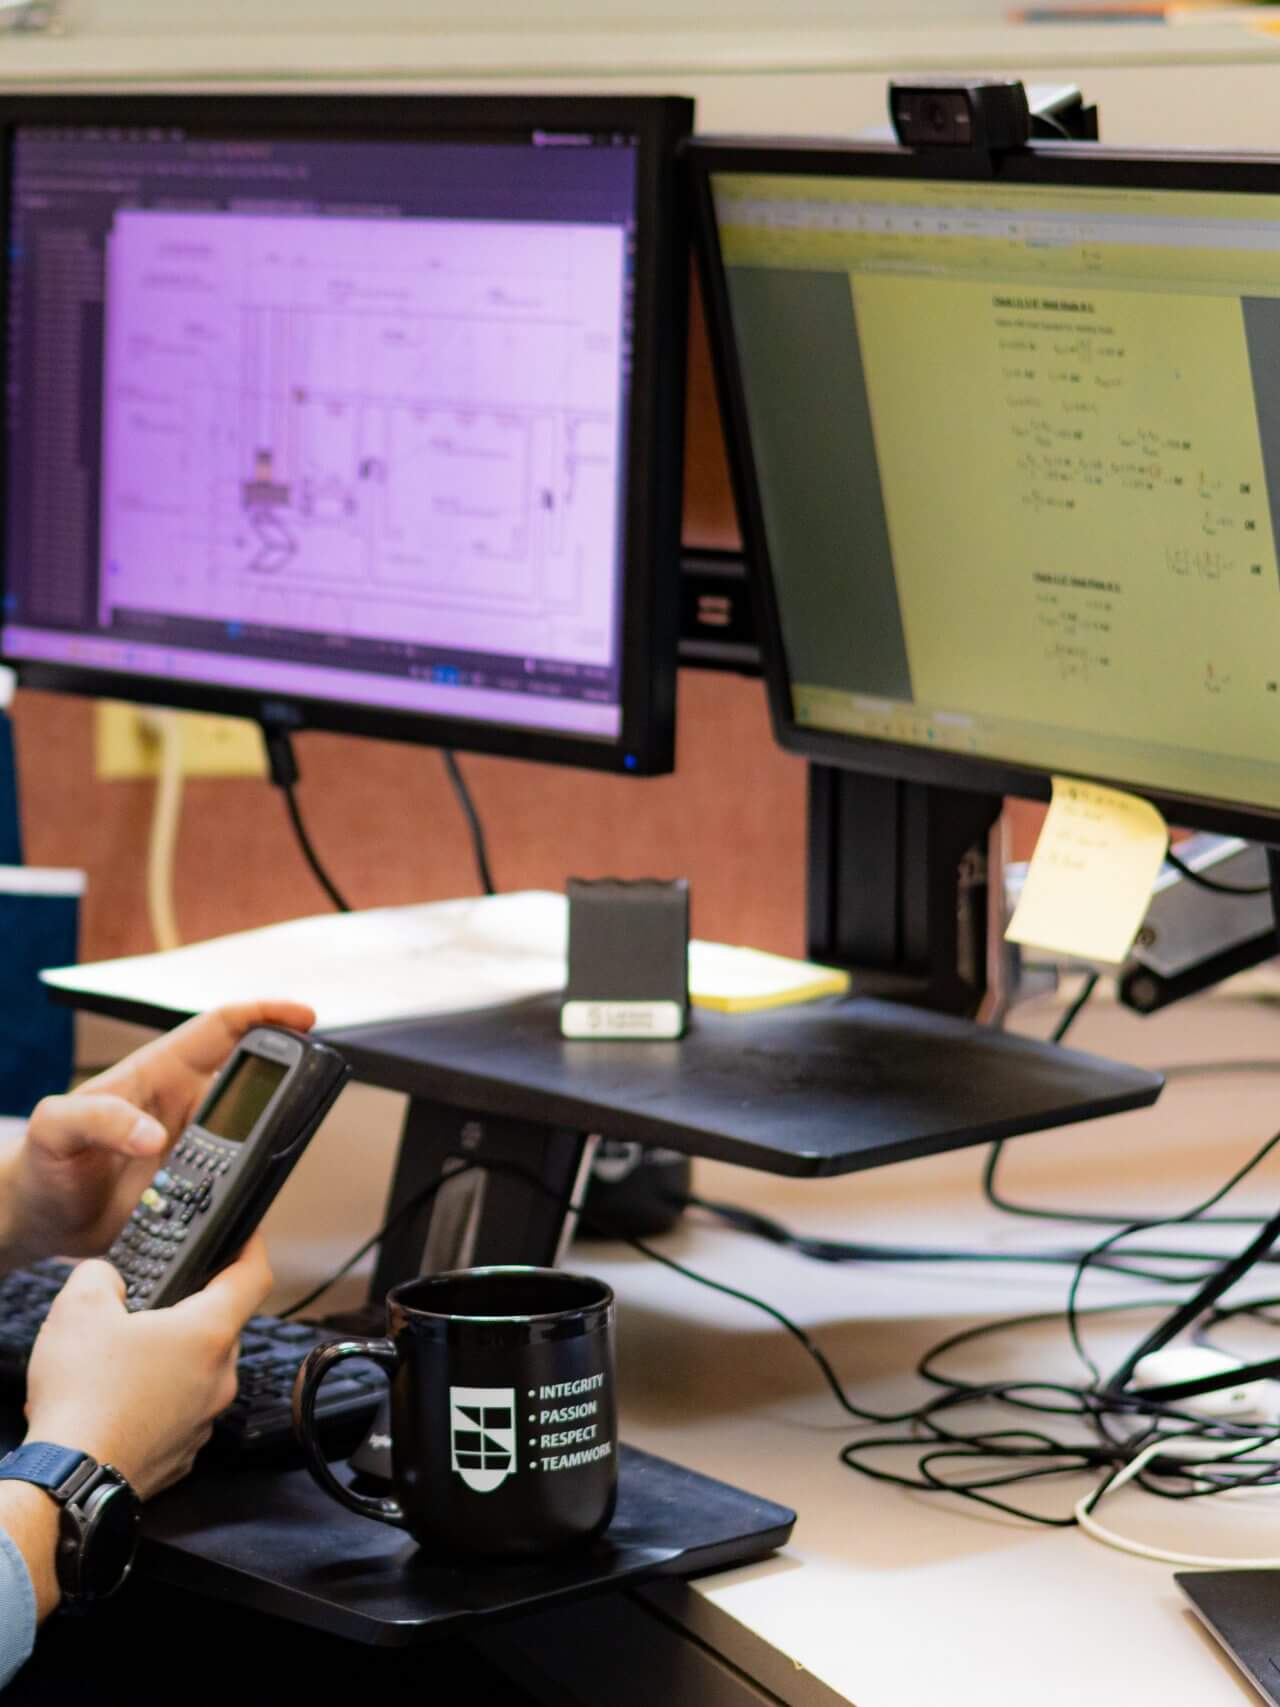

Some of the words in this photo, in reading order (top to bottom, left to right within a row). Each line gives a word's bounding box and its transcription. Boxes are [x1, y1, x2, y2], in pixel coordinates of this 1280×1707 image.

[540, 1373, 604, 1399] INTEGRITY
[540, 1400, 597, 1425] PASSION
[540, 1425, 597, 1448] RESPECT
[541, 1442, 611, 1471] TEAMWORK
